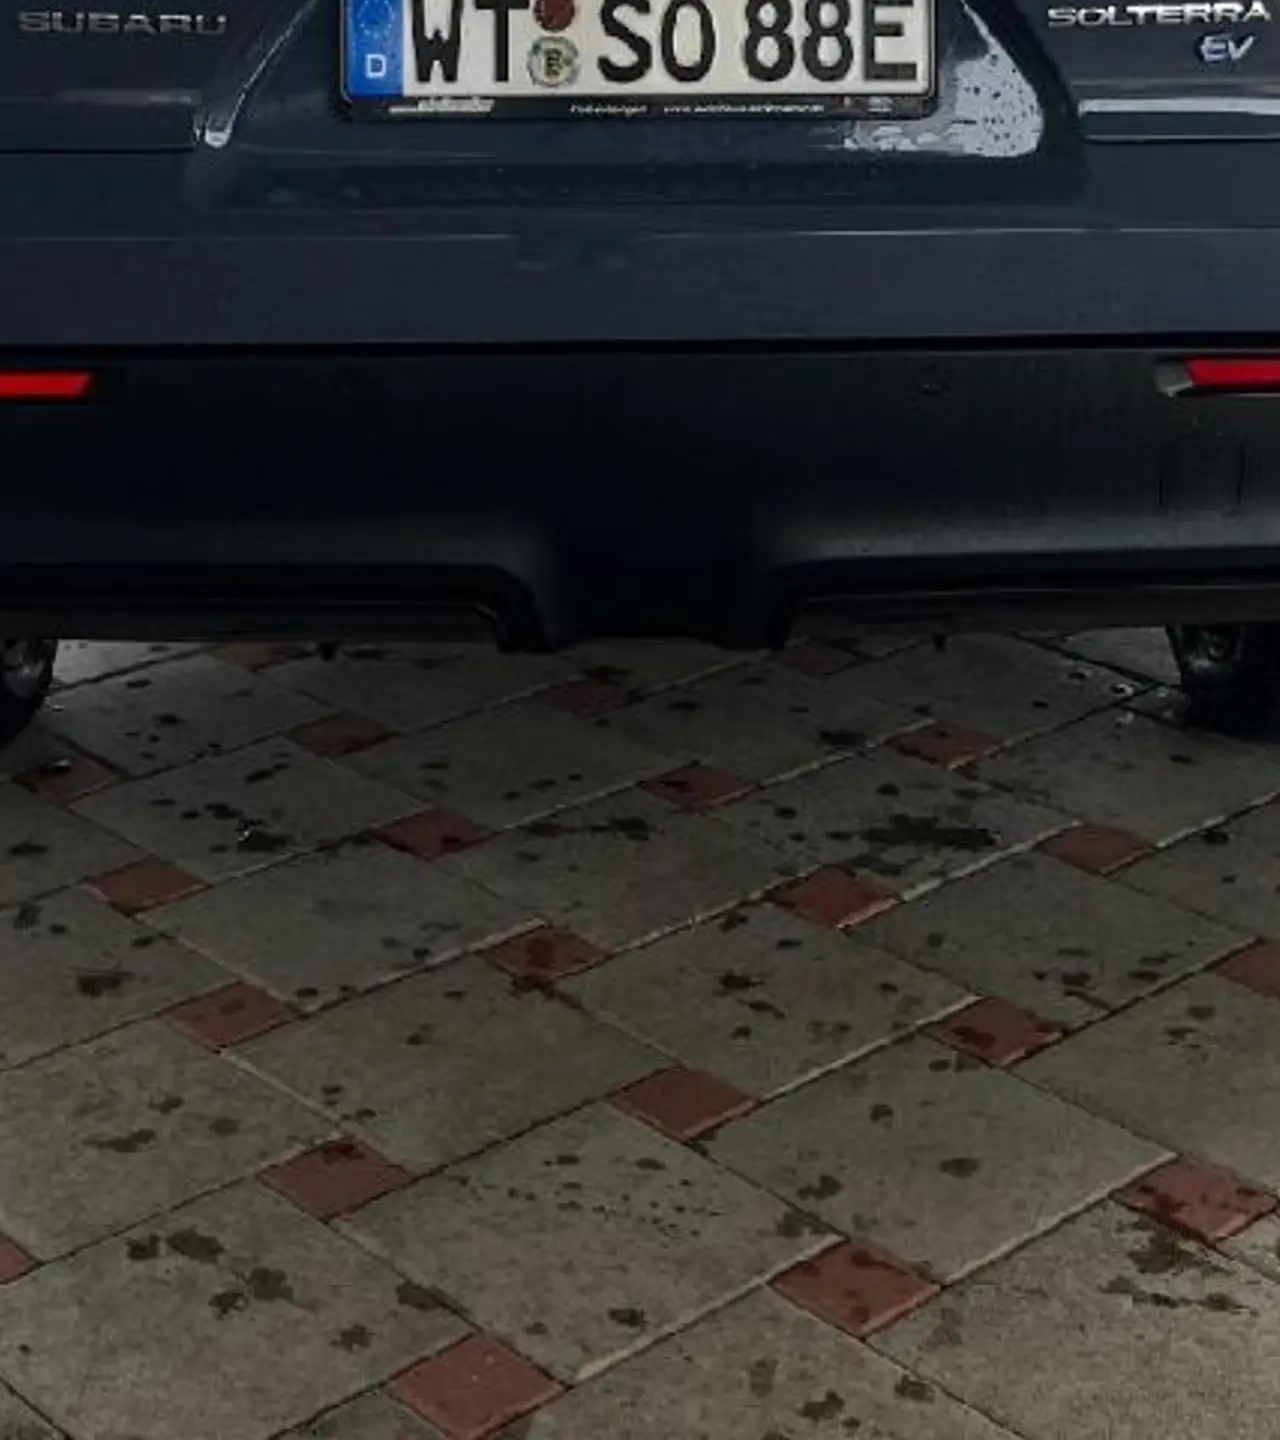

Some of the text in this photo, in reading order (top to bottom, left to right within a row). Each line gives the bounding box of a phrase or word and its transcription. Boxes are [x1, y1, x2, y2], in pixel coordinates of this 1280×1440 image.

[19, 12, 227, 34] SUBARU
[1047, 0, 1271, 28] SOLTERRA
[1201, 33, 1257, 61] EV
[365, 54, 387, 78] D
